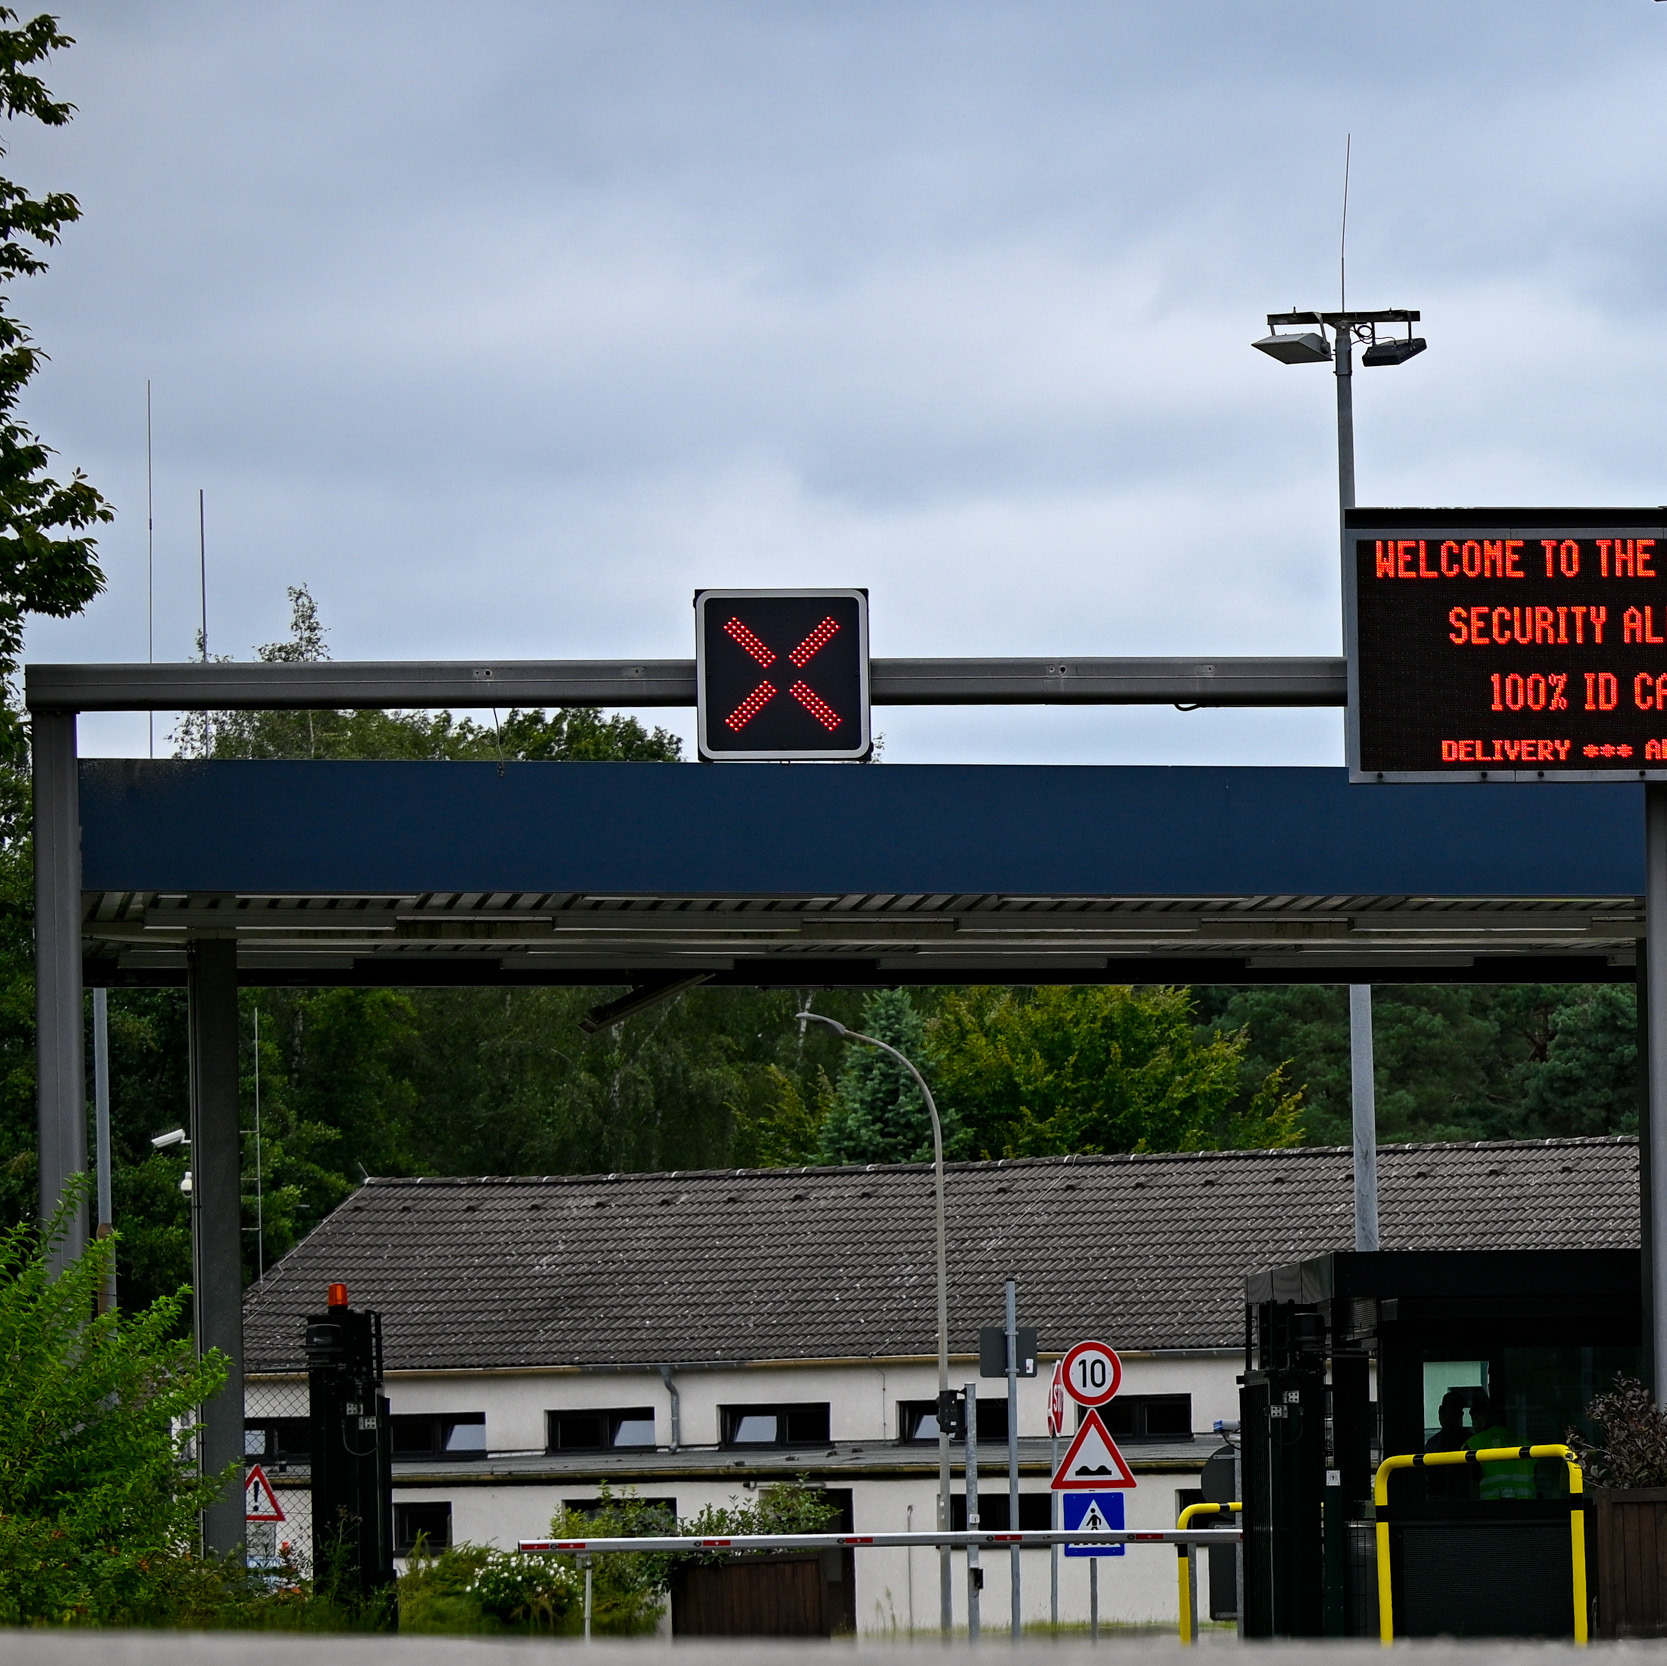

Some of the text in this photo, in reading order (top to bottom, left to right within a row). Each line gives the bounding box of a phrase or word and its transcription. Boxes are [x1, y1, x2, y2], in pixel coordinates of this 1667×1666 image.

[1375, 539, 1525, 579] WELCOME
[1540, 539, 1580, 578] TO
[1595, 538, 1657, 578] THE
[1448, 605, 1607, 645] SECURITY
[1490, 672, 1568, 712] 100%
[1583, 672, 1618, 711] ID
[1441, 739, 1572, 762] DELIVERY
[1078, 1358, 1106, 1389] 10
